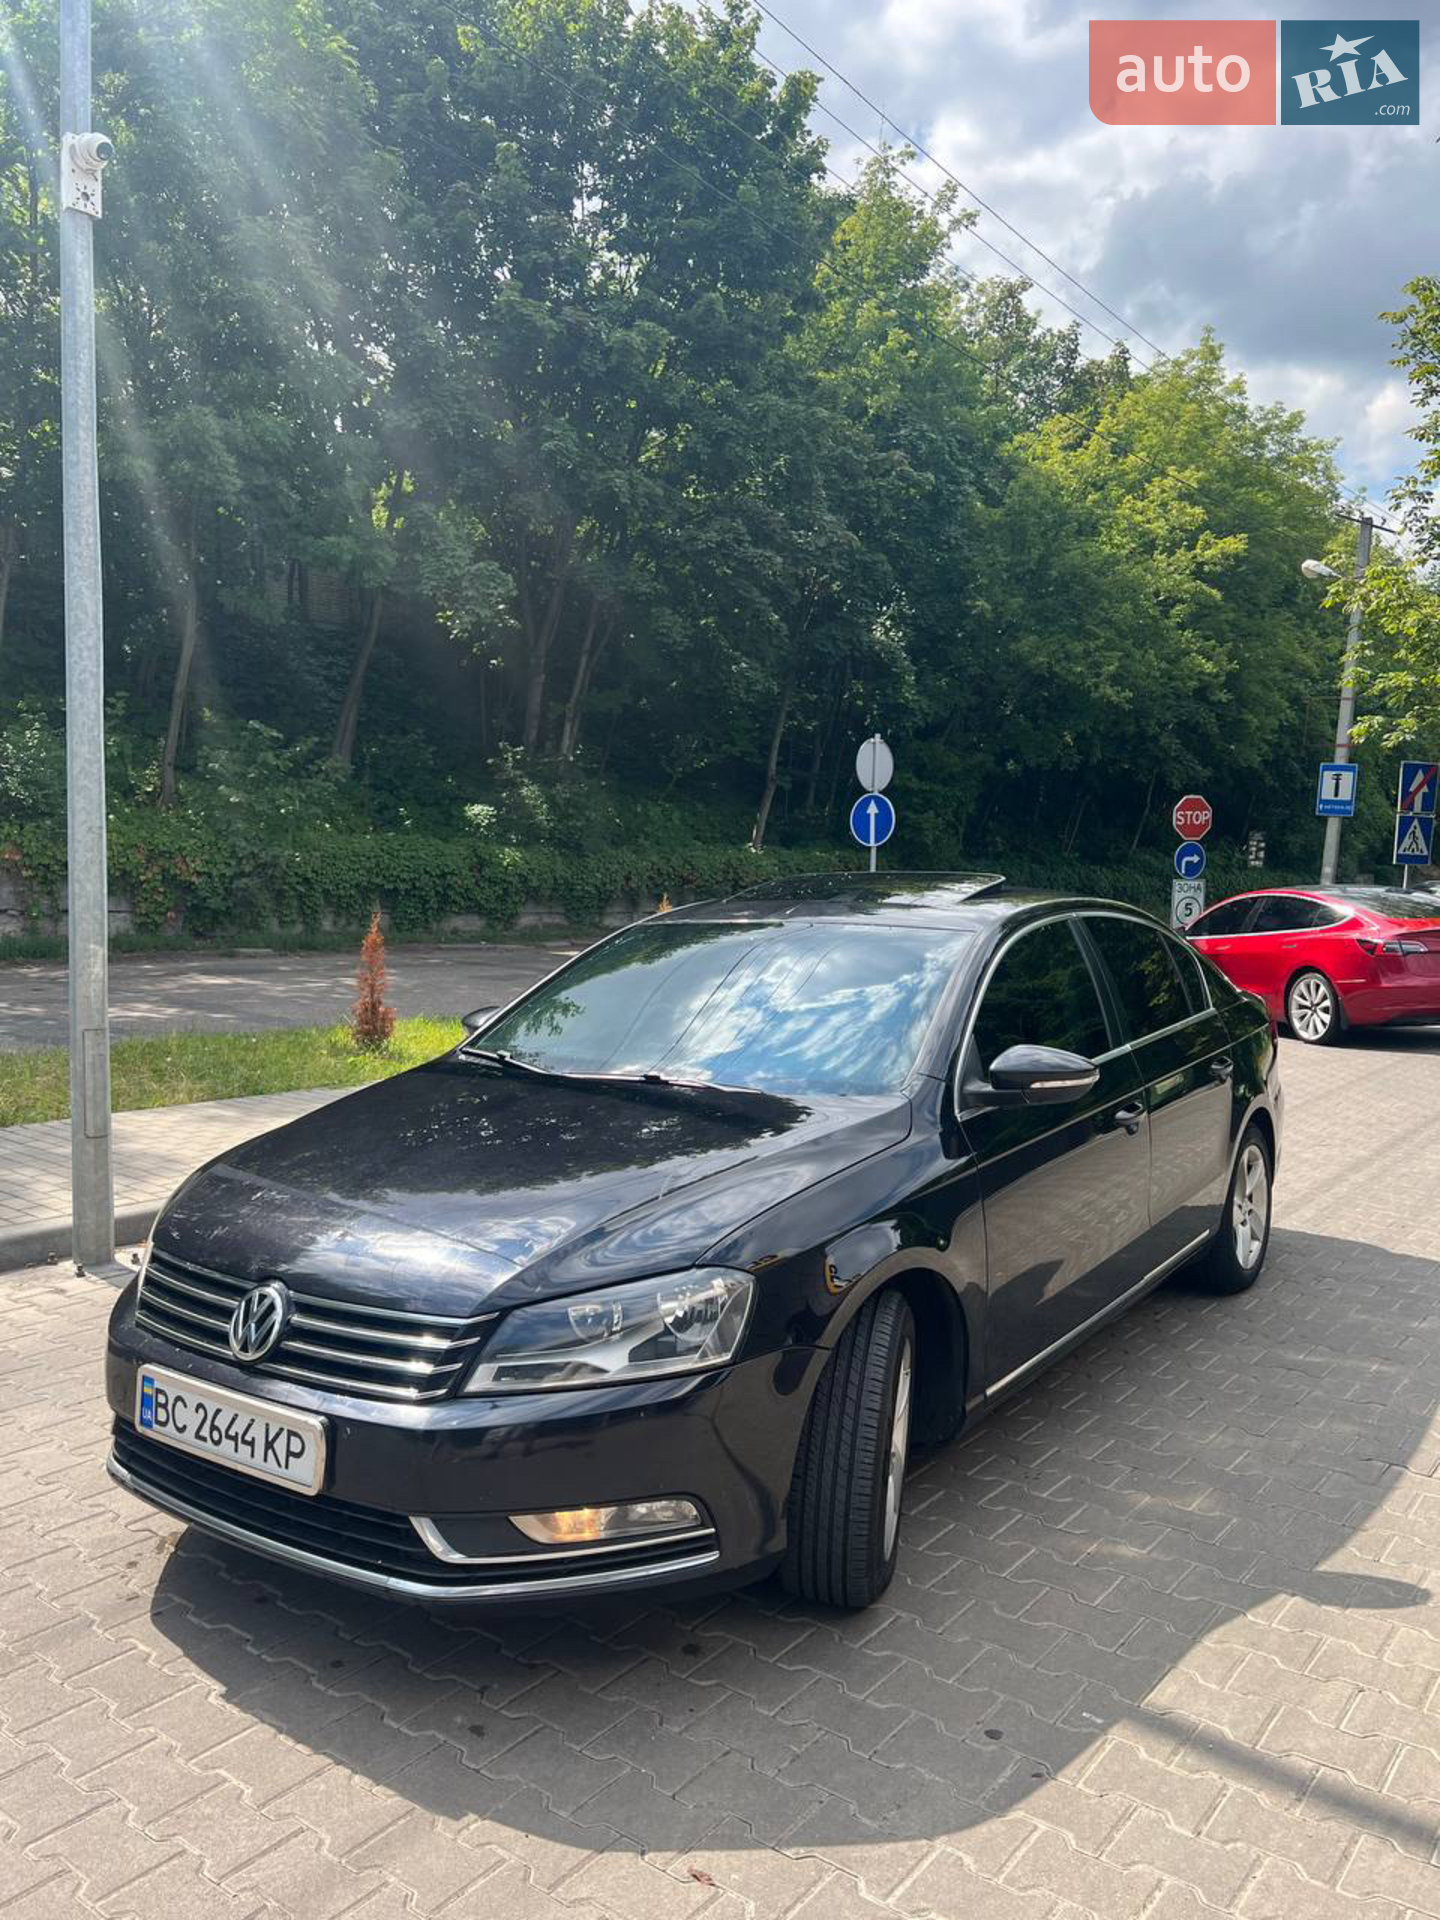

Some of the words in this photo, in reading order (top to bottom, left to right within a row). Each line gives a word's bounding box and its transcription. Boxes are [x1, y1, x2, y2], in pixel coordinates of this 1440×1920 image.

[1176, 811, 1210, 825] STOP
[1176, 882, 1202, 893] ЗОНА
[1184, 902, 1193, 917] 5
[154, 1387, 188, 1435] BC
[194, 1402, 256, 1460] 2644
[263, 1422, 306, 1470] KP
